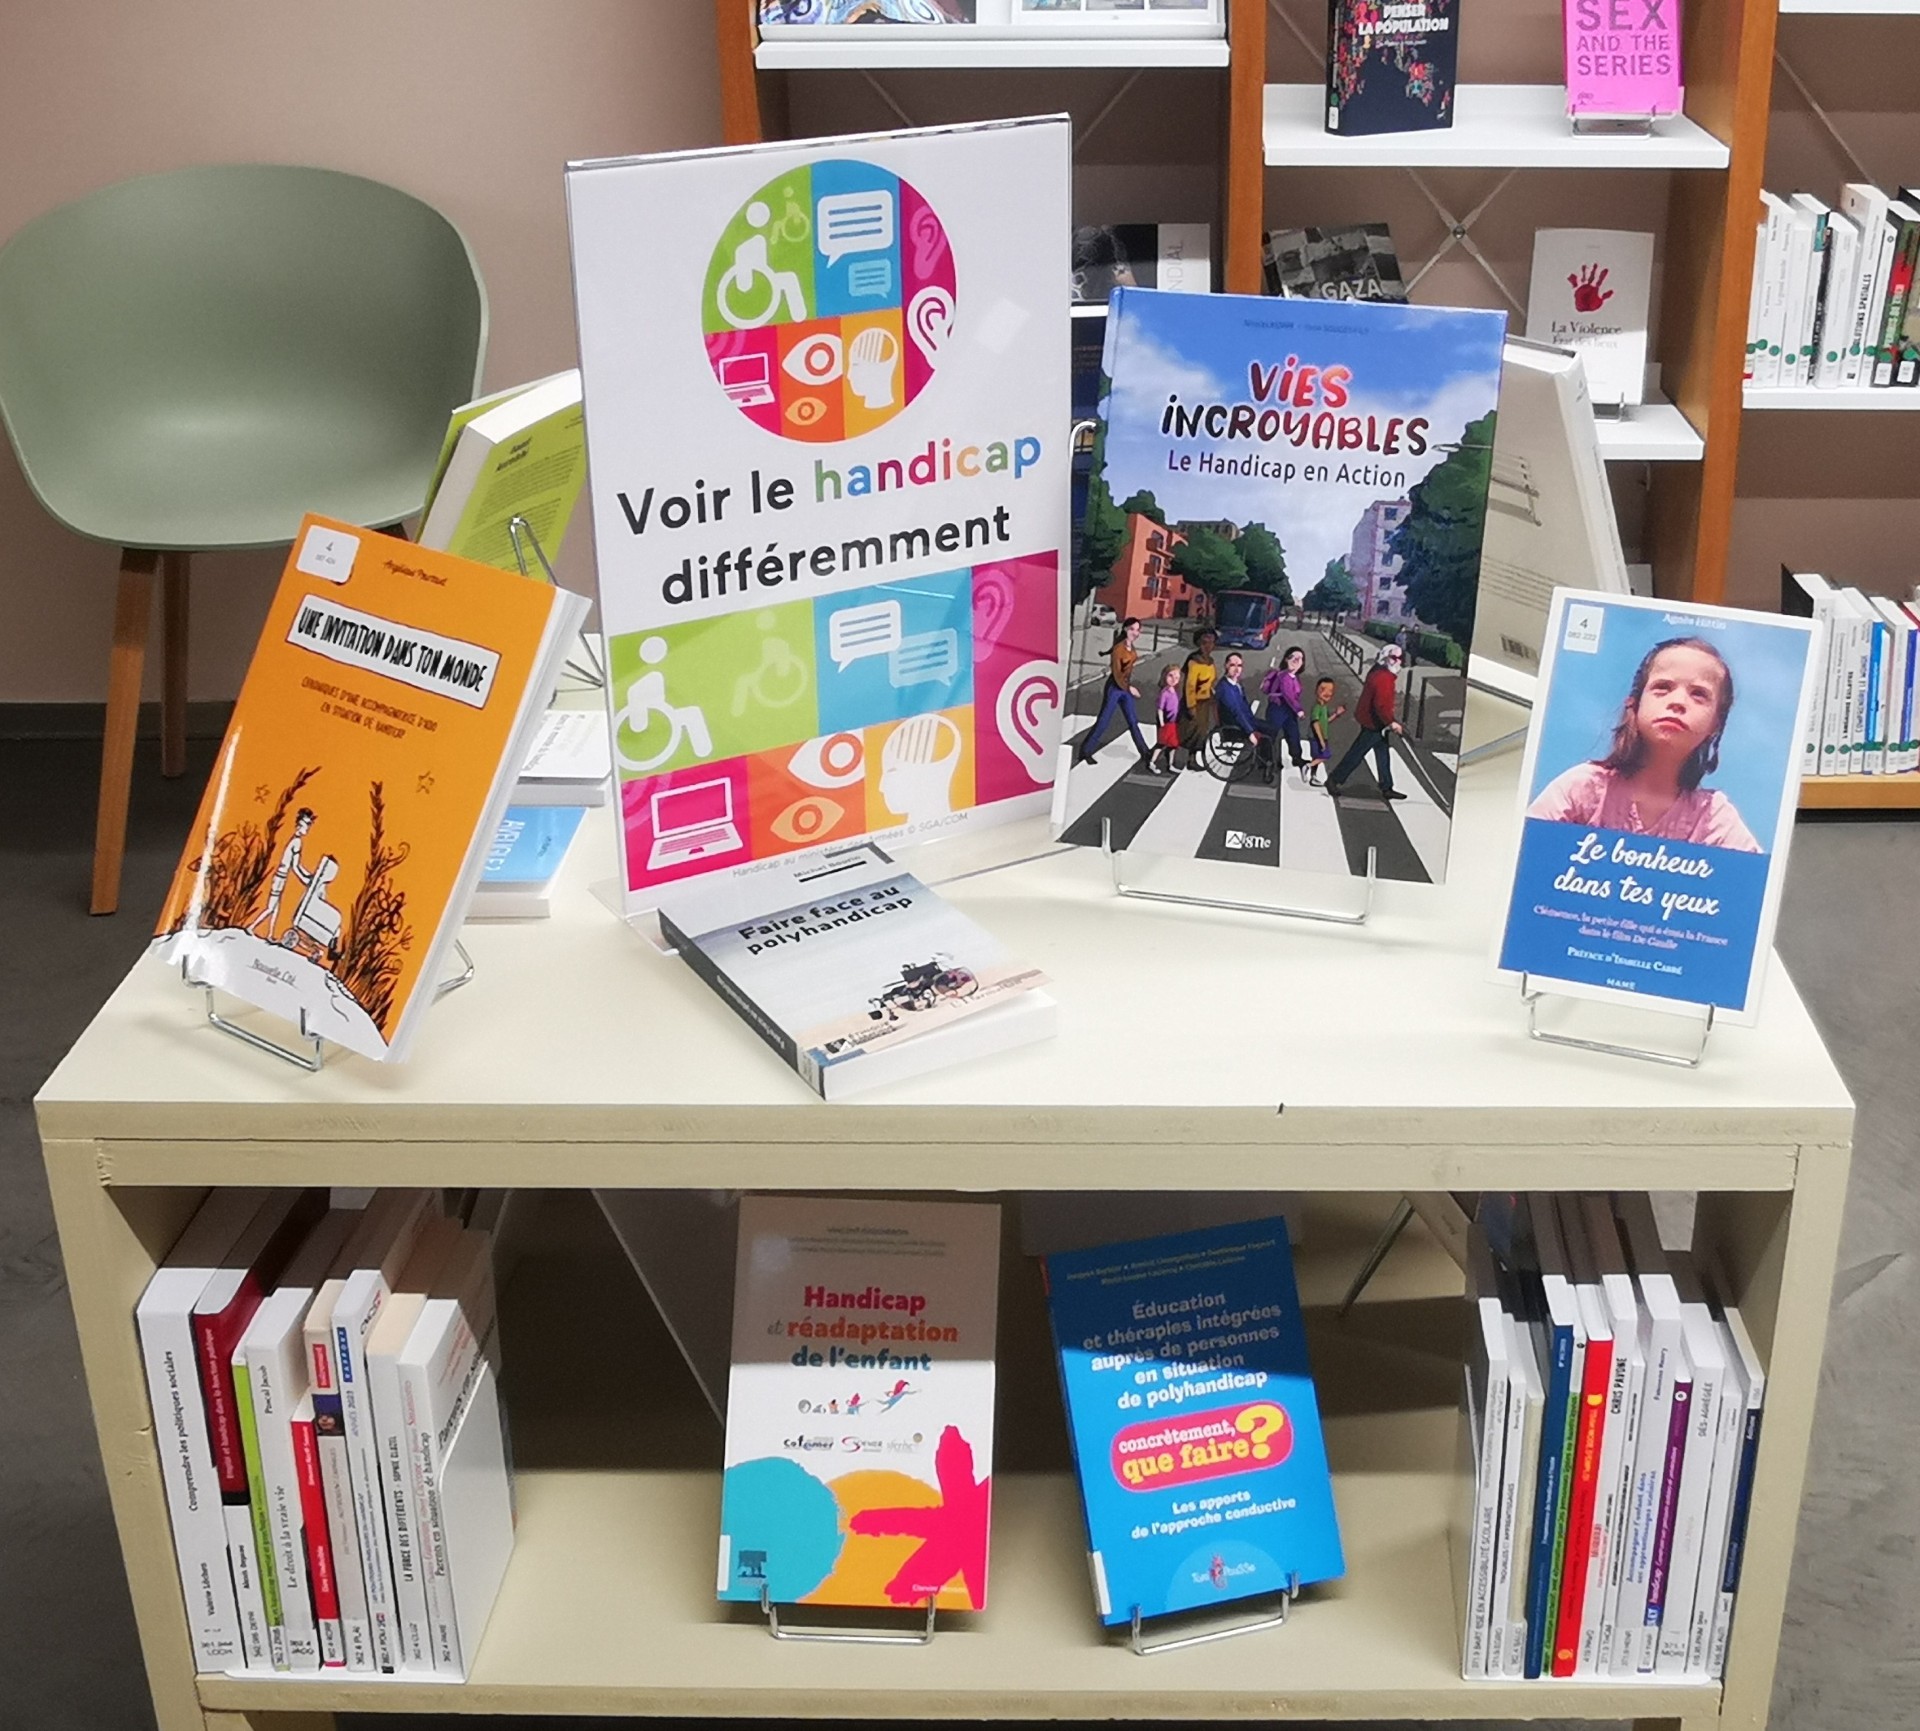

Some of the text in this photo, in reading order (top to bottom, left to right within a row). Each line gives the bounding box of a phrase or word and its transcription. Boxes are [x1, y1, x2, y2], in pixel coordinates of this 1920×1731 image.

[1358, 17, 1449, 35] LA POPULATION
[1383, 4, 1426, 18] PENSER
[1576, 0, 1668, 31] SEX
[1576, 34, 1670, 52] AND THE
[1577, 54, 1671, 76] SERIES
[1168, 239, 1184, 291] NDIAL
[1321, 279, 1382, 300] GAZA
[1570, 321, 1622, 335] Violence
[1168, 449, 1406, 488] Le Handicap en Action
[617, 480, 731, 535] Voir
[751, 469, 795, 514] le
[815, 436, 1041, 502] handicap
[661, 506, 1010, 605] différemment
[1579, 618, 1589, 630] 4
[297, 606, 488, 692] UNE INVITATION DANS TON MONDE
[1570, 833, 1714, 878] Le bonheur
[1553, 867, 1720, 920] dans tes yeux
[739, 884, 901, 940] Faire face au
[747, 895, 913, 956] polyhandicap
[1607, 977, 1636, 990] MAME
[804, 1286, 926, 1316] Handicap
[1132, 1292, 1226, 1320] Éducation
[767, 1315, 959, 1345] et réadaptation
[1083, 1303, 1282, 1351] et thérapies intégrées
[792, 1346, 931, 1371] de l'enfant
[1091, 1326, 1280, 1373] auprès de personnes
[1135, 1353, 1244, 1385] en situation
[1117, 1370, 1268, 1410] de polyhandicap
[1611, 1357, 1627, 1414] CHRIS PAVONE
[164, 1351, 198, 1512] Comprendre les politiques sociales
[1118, 1418, 1236, 1454] concrètement,
[393, 1458, 402, 1483] SOPHIE
[1122, 1454, 1174, 1484] que
[274, 1484, 286, 1501] vie
[420, 1432, 446, 1577] Parents en situation de handicap
[1172, 1490, 1251, 1515] Les apports
[277, 1504, 290, 1529] vraie
[1131, 1497, 1297, 1539] de l'approche conductive
[280, 1530, 291, 1541] la
[400, 1534, 410, 1552] DES
[284, 1553, 297, 1576] droit
[402, 1552, 413, 1572] FORCE
[287, 1576, 298, 1588] Le
[404, 1573, 414, 1582] LA
